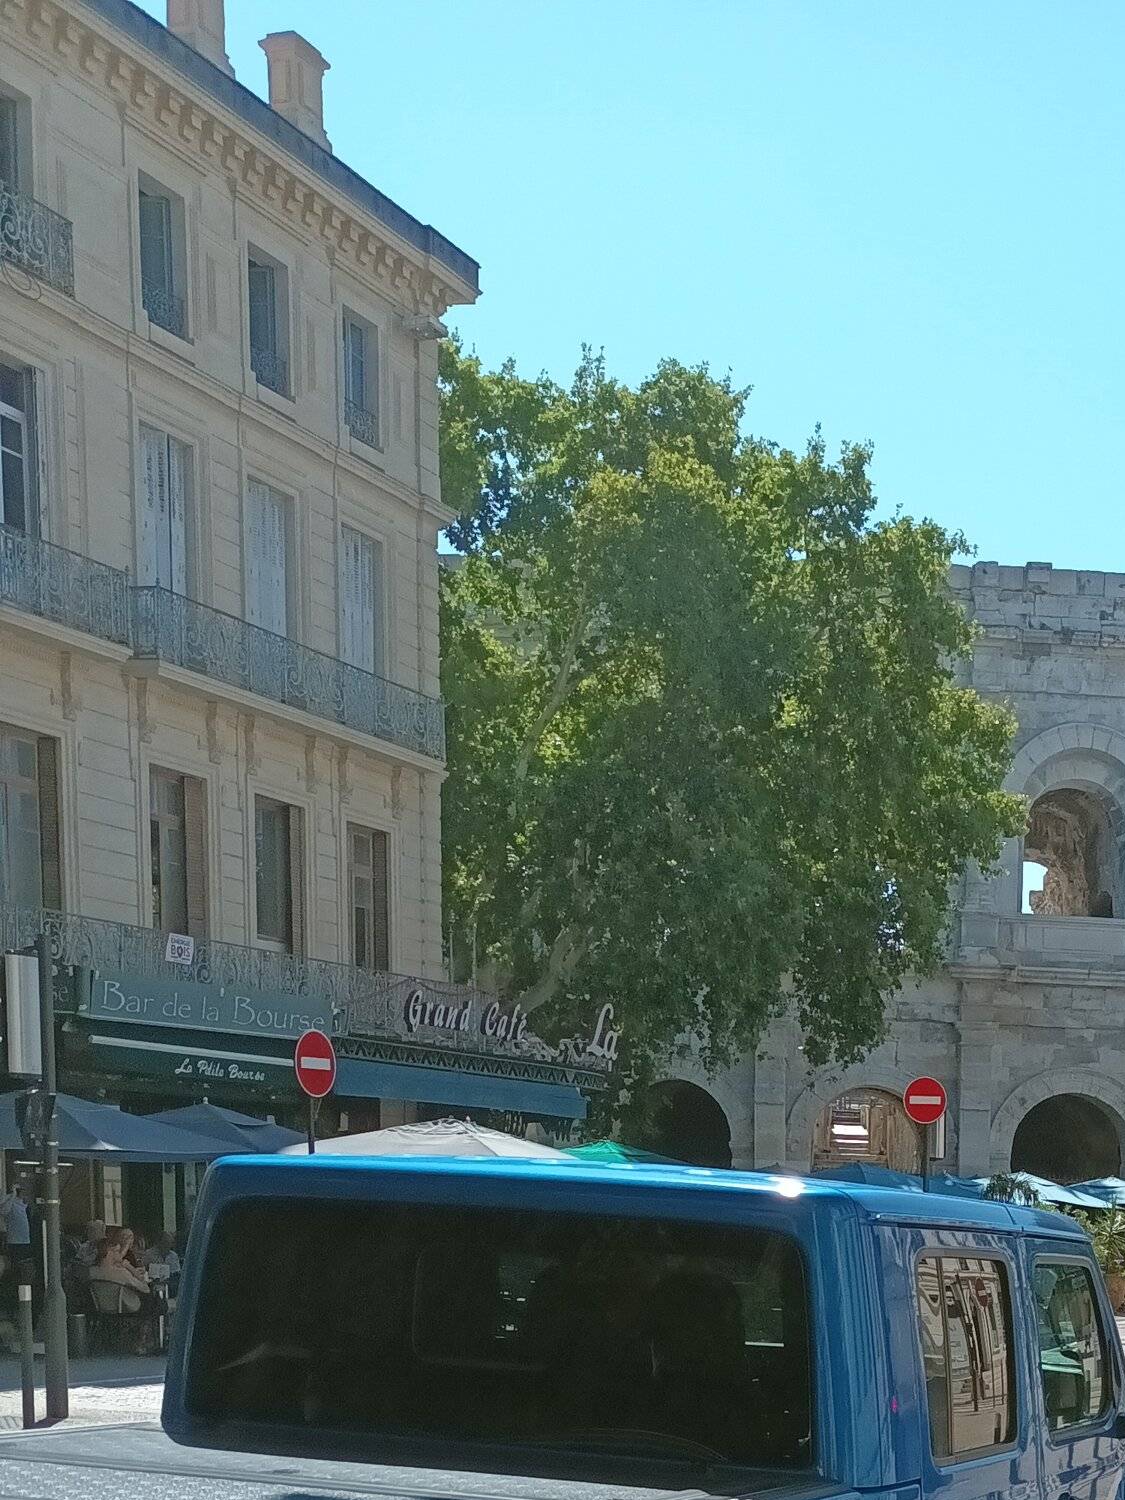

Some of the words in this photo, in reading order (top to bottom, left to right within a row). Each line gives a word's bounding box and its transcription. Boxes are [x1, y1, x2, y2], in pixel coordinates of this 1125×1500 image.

[101, 981, 155, 1013] Bar
[163, 992, 191, 1018] de
[202, 996, 219, 1021] la
[232, 996, 325, 1030] Bourse
[407, 990, 472, 1032] Grand
[484, 1002, 528, 1041] Café
[586, 1003, 619, 1060] La
[228, 1064, 265, 1080] Bourse
